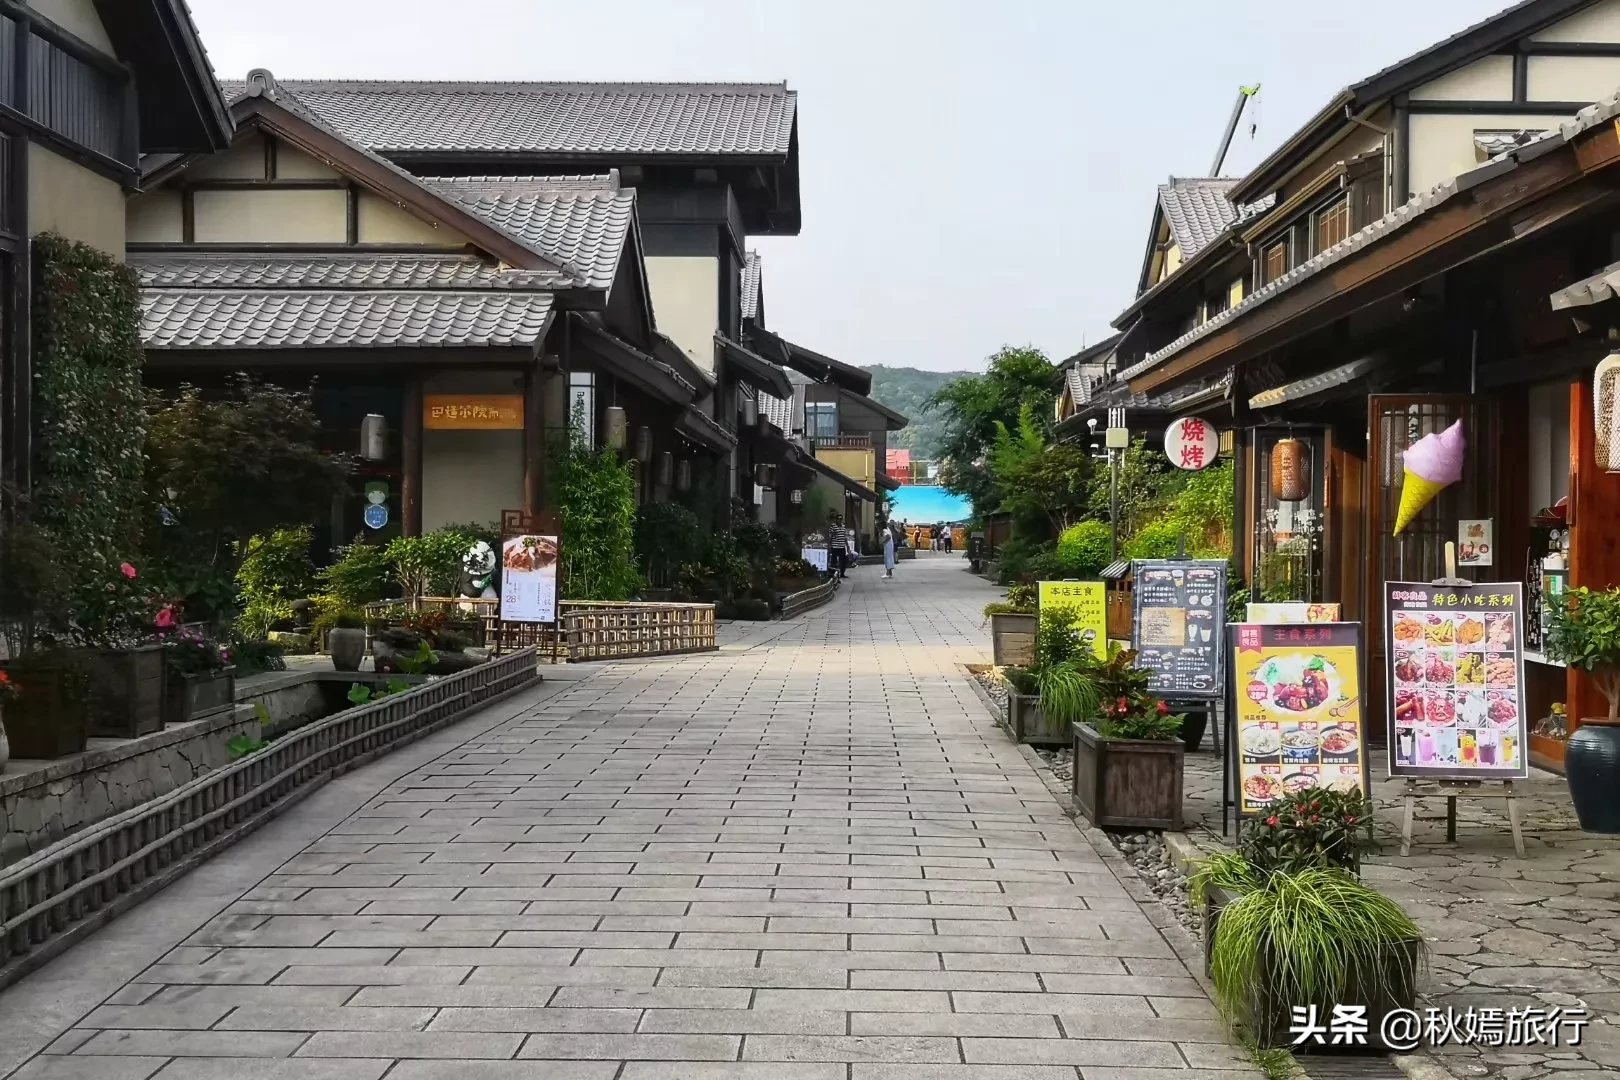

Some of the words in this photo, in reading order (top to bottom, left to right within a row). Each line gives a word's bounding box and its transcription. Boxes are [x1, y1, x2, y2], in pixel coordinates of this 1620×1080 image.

[1180, 418, 1205, 468] 烧烤
[1050, 586, 1094, 596] 本店主食
[506, 595, 516, 603] 28
[1432, 593, 1514, 606] 特色小吃系列
[1274, 628, 1332, 640] 主食系列
